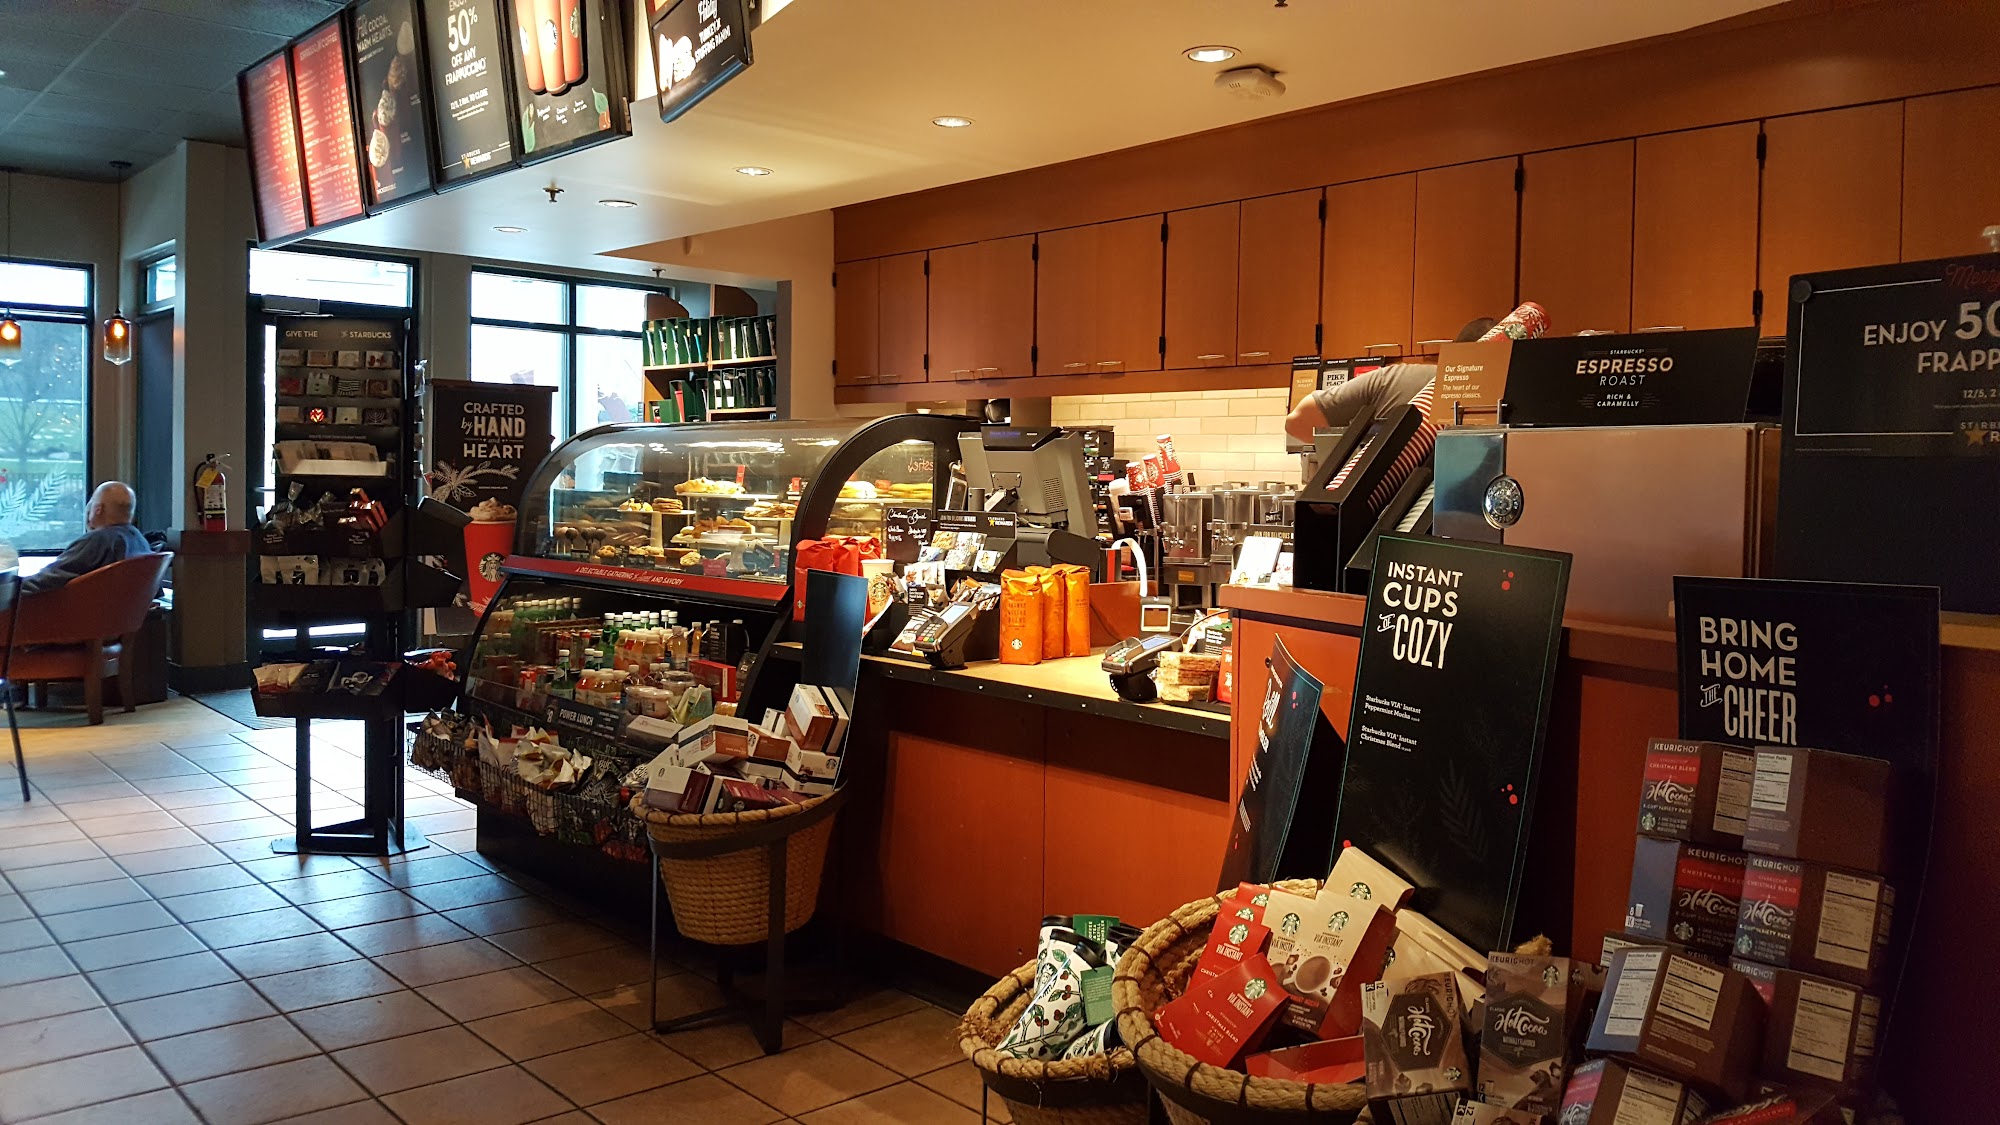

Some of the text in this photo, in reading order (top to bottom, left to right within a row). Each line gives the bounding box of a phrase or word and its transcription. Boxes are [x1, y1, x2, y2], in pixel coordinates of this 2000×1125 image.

[448, 6, 478, 52] 50%
[321, 32, 338, 48] COFFEE
[451, 46, 476, 68] OFF ANY
[1864, 320, 1947, 346] ENJOY
[1457, 364, 1484, 373] Signature
[1576, 357, 1674, 375] ESPRESSO
[1444, 374, 1470, 382] Espresso
[1600, 374, 1646, 386] ROAST
[1990, 388, 1997, 398] 2
[463, 401, 524, 416] CRAFTED
[461, 416, 526, 438] by HAND
[463, 444, 524, 460] HEART
[580, 567, 607, 576] DELECTABLE
[607, 570, 634, 580] GATHERING
[662, 576, 684, 586] SAVORY
[1388, 561, 1464, 589] INSTANT
[1383, 582, 1459, 618] CUPS
[1392, 614, 1454, 670] COZY
[1700, 616, 1798, 651] BRING
[1700, 648, 1797, 687] HOME
[1365, 702, 1394, 715] Peppermint
[1394, 710, 1410, 720] Mocha
[1366, 694, 1390, 706] Starbucks
[1402, 704, 1421, 714] Instant
[560, 708, 577, 721] POWER
[576, 713, 594, 726] LUNCH
[1724, 684, 1798, 746] CHEER
[1360, 732, 1402, 750] Christmas Blend
[1362, 724, 1386, 737] Starbucks
[1398, 734, 1418, 746] Instant
[1682, 868, 1721, 881] CHRISTMAS
[1828, 872, 1872, 886] Nutrition Facts
[1746, 880, 1797, 894] CHRISTMAS BLEND
[1271, 939, 1279, 948] VIA
[1314, 934, 1344, 948] VIA INSTANT
[1778, 932, 1792, 940] PACK
[1216, 944, 1244, 962] VIA INSTANT
[1672, 956, 1716, 976] Nutrition Facts
[1376, 982, 1384, 990] 12
[1802, 981, 1848, 996] Nutrition Facts
[1227, 992, 1254, 1018] VIA INSTANT
[1206, 1010, 1239, 1044] CHRISTMAS BLEND
[1630, 1068, 1674, 1087] Nutrition Facts
[1466, 1106, 1474, 1116] 12
